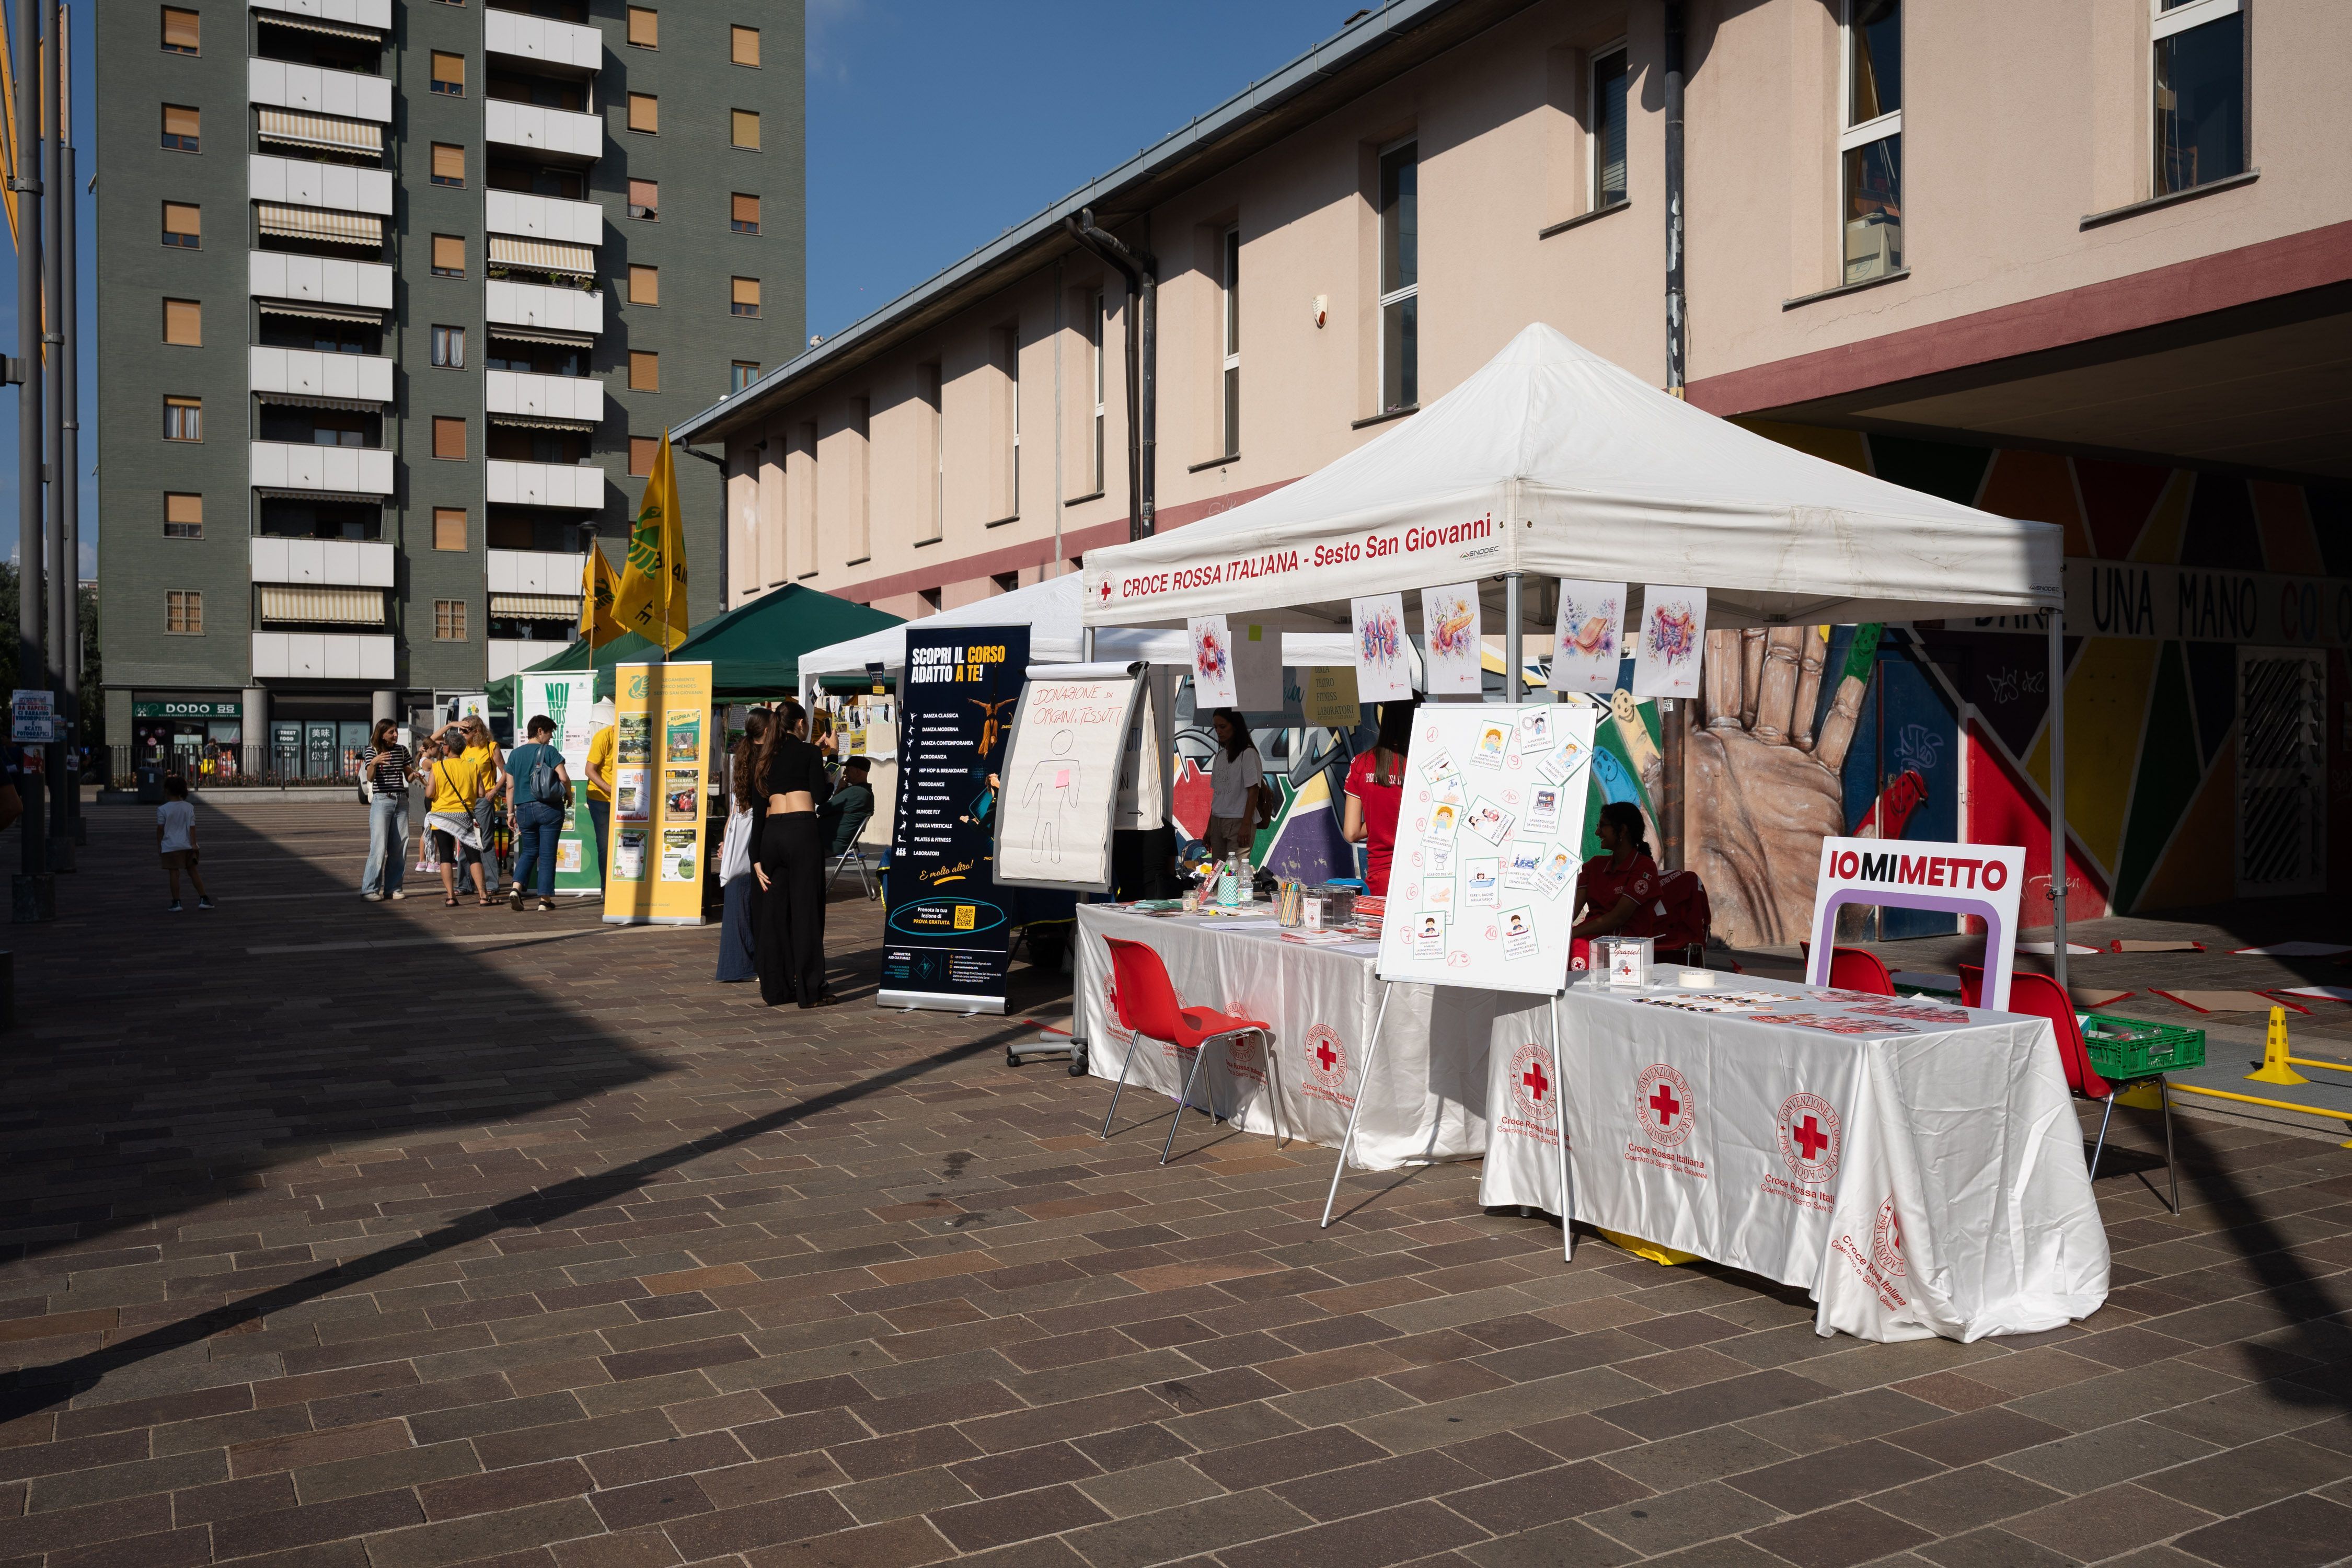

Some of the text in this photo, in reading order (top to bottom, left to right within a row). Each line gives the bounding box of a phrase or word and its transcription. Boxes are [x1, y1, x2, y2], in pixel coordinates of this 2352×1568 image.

[1123, 573, 1169, 598] CROCE
[1172, 564, 1221, 591] ROSSA
[1226, 550, 1298, 582] ITALIANA
[1313, 541, 1360, 567] Sesto
[1365, 535, 1399, 558] San
[1405, 512, 1491, 551] Giovanni
[2092, 567, 2154, 635] UNA
[2178, 572, 2257, 639] MANO
[912, 645, 1006, 665] SCOPRI IL CORSO
[911, 664, 984, 683] ADATTO A TE!
[1316, 678, 1334, 687] TEATRO
[545, 683, 570, 709] NOI
[1033, 685, 1102, 706] DONAZIONE
[1317, 691, 1338, 701] FITNESS
[166, 704, 210, 713] DODO
[217, 705, 235, 713] 豆豆
[1033, 707, 1075, 725] ORGANI
[1080, 707, 1123, 727] TESSUTI
[1317, 705, 1354, 716] LABORATORI
[312, 728, 330, 738] 美味
[1497, 814, 1507, 829] CUCINARE
[919, 859, 974, 881] E molto altro!
[1829, 850, 2008, 891] IOMIMETTO
[1614, 948, 1641, 957] Grazie!
[1302, 1082, 1318, 1092] Croce
[1336, 1092, 1356, 1103] Italiana
[1638, 1067, 1692, 1144] CONVENZIONE DI GINEVRA 22 AGOSTO 1864
[1629, 1143, 1704, 1169] Croce Rossa Italiana
[1765, 1174, 1835, 1204] Croce Rossa Itali
[1843, 1235, 1907, 1306] Croce Italiana
